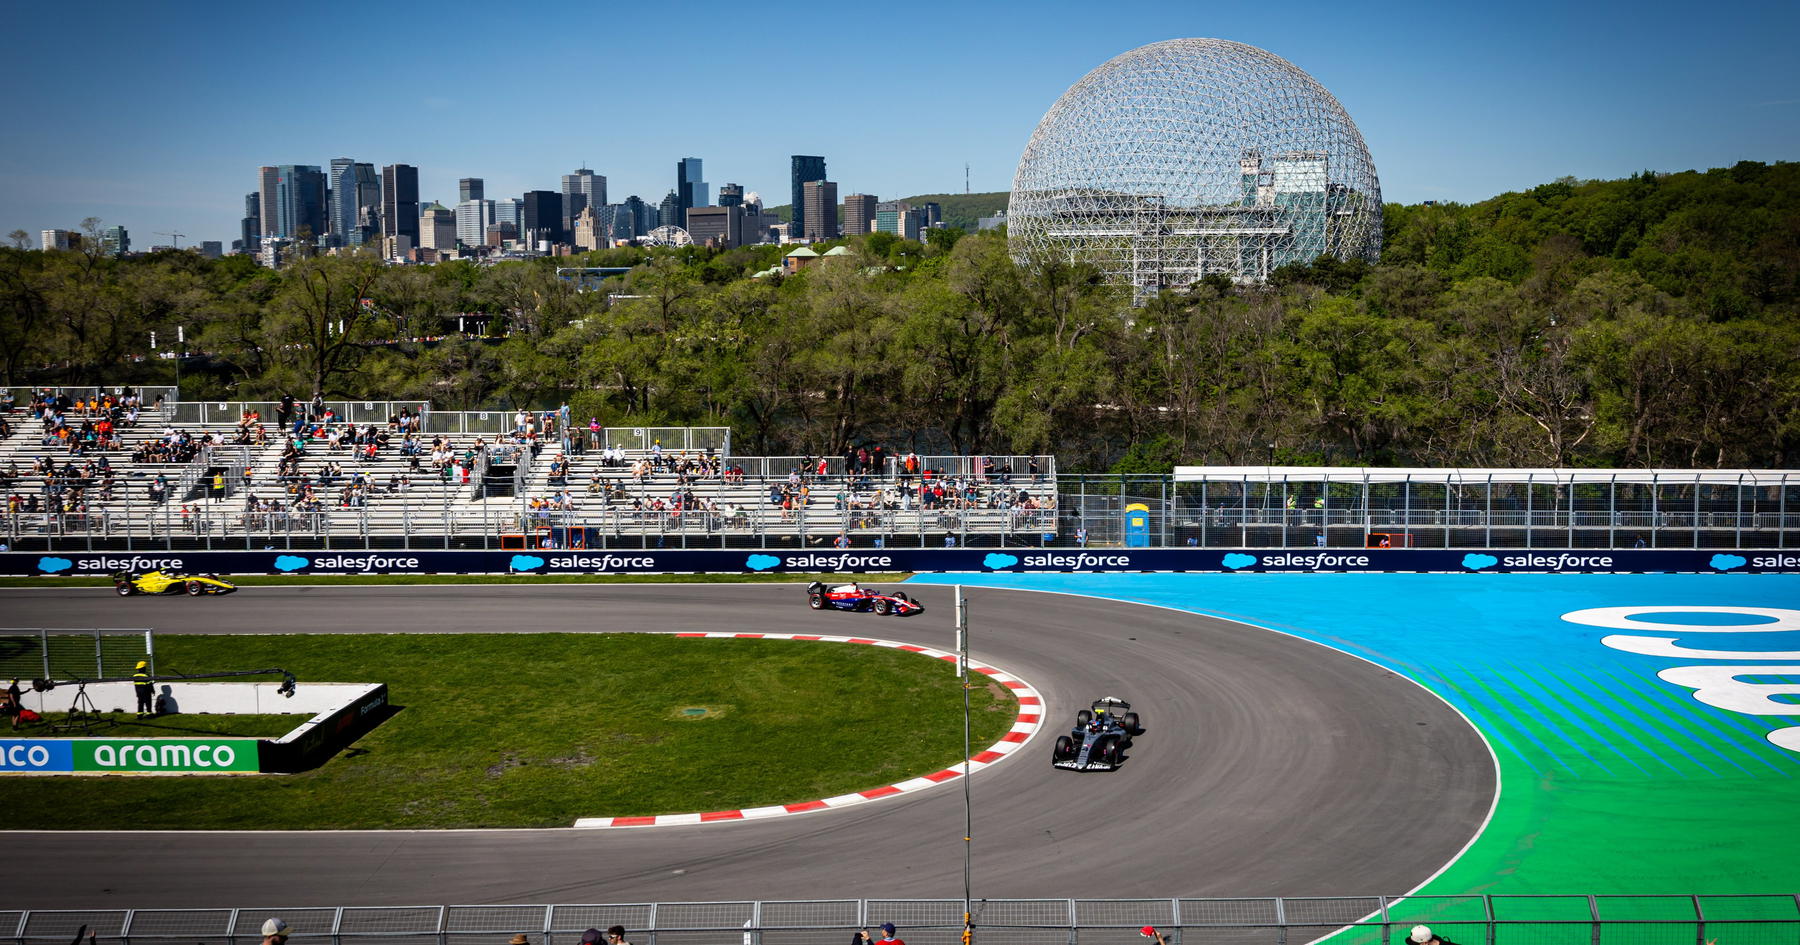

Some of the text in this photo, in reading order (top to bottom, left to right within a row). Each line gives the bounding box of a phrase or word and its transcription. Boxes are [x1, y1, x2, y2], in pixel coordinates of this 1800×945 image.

[78, 556, 183, 572] salesforce
[314, 555, 419, 571] salesforce
[549, 554, 655, 571] salesforce
[786, 554, 892, 570] salesforce
[1023, 552, 1130, 569] salesforce
[1262, 552, 1370, 569] salesforce
[1503, 553, 1613, 570] salesforce
[1752, 553, 1800, 567] sale
[360, 697, 381, 716] Formula
[94, 744, 235, 767] aramco
